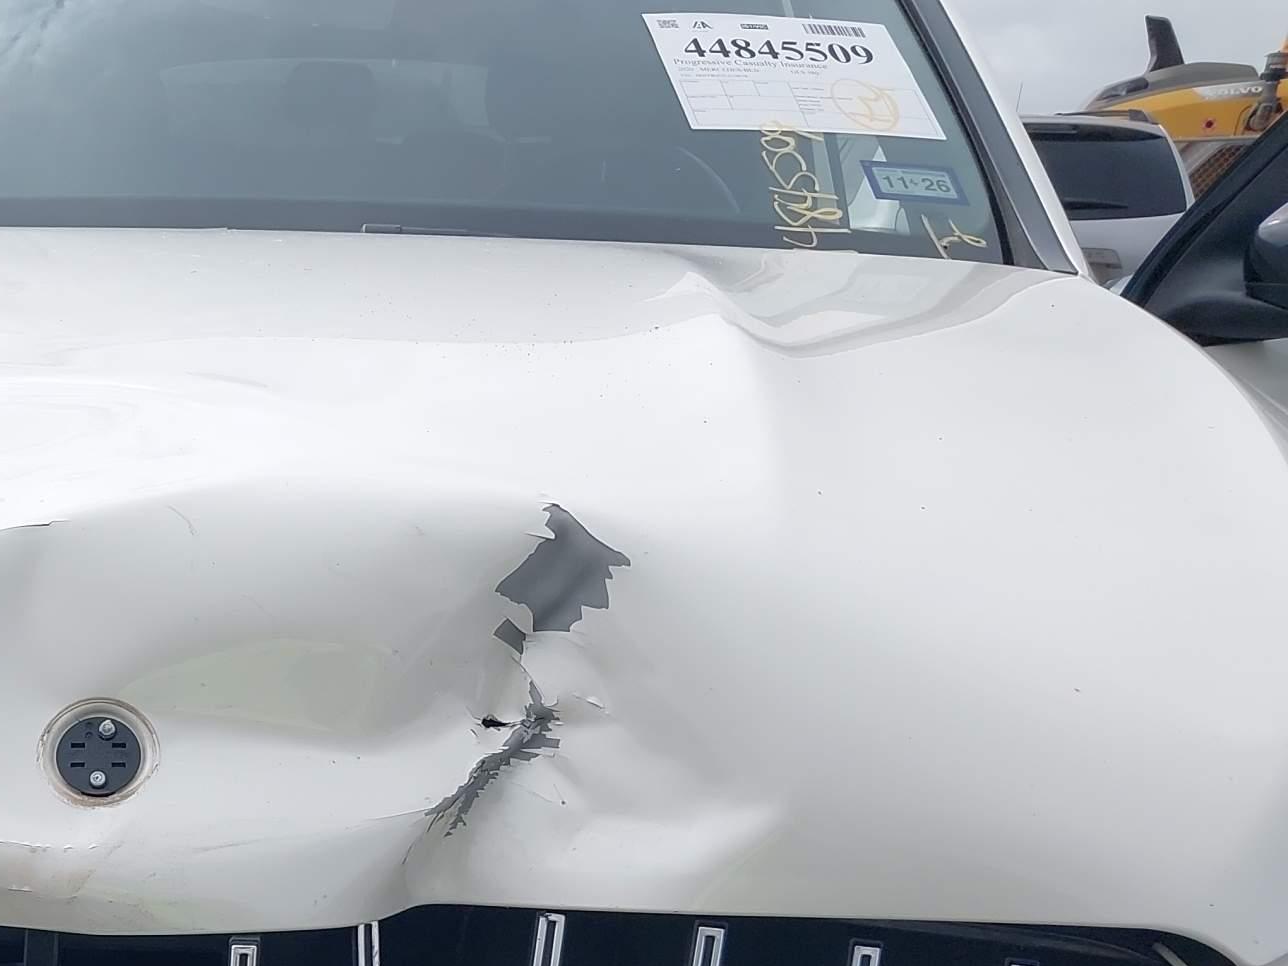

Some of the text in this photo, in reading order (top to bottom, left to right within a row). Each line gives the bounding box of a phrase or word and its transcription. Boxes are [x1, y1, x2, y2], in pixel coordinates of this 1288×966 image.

[684, 38, 874, 65] 44845509
[673, 59, 828, 70] Progressive Casualty Insurance
